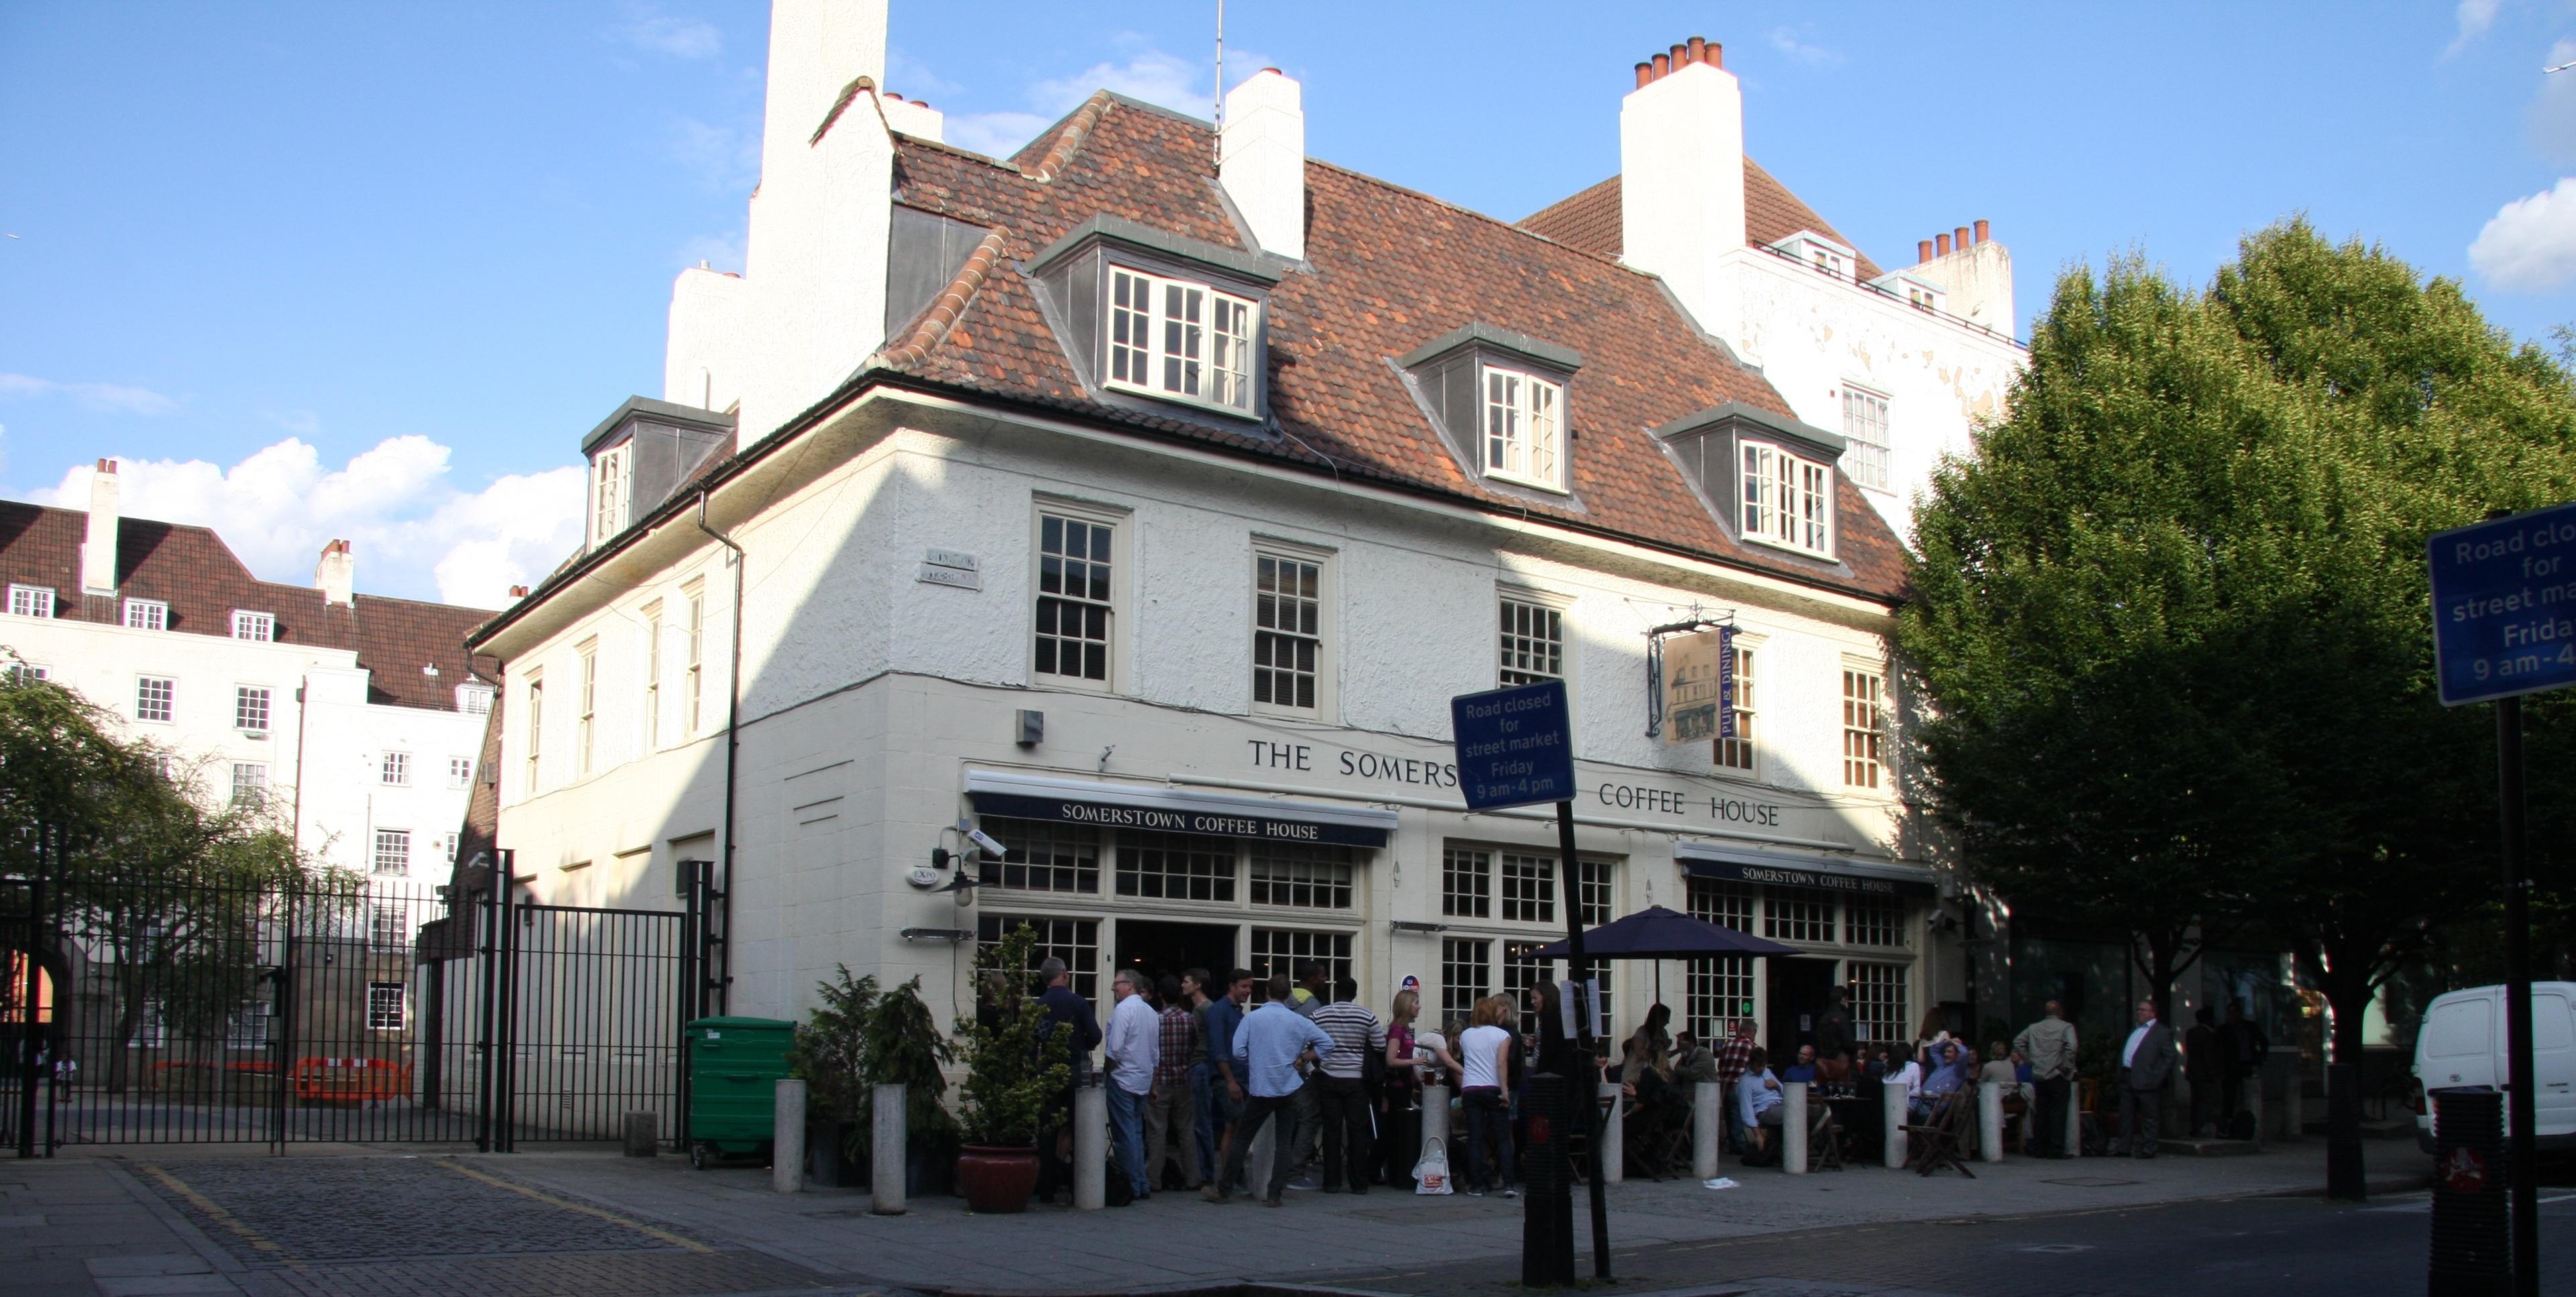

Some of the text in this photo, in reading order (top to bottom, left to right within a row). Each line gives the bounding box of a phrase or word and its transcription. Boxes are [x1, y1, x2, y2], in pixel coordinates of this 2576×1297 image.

[2456, 522, 2576, 565] Road clo
[2522, 556, 2561, 578] for
[2453, 587, 2533, 622] street
[2503, 617, 2576, 648] Frida
[1721, 632, 1732, 734] PUB & DINING
[2473, 659, 2490, 681] 9
[1466, 691, 1552, 720] Road closed
[1500, 718, 1519, 733] for
[1248, 740, 1311, 771] THE
[1466, 730, 1560, 758] street market
[1491, 760, 1534, 778] Friday
[1476, 785, 1486, 799] 9
[1532, 778, 1554, 794] pm
[1599, 783, 1779, 826] COFFEE HOUSE
[1062, 804, 1318, 840] SOMERSTOWN COFFEE HOUSE
[914, 870, 936, 879] EXPO
[1742, 867, 1894, 894] SOMERSTOWN COFFEE HOUSE
